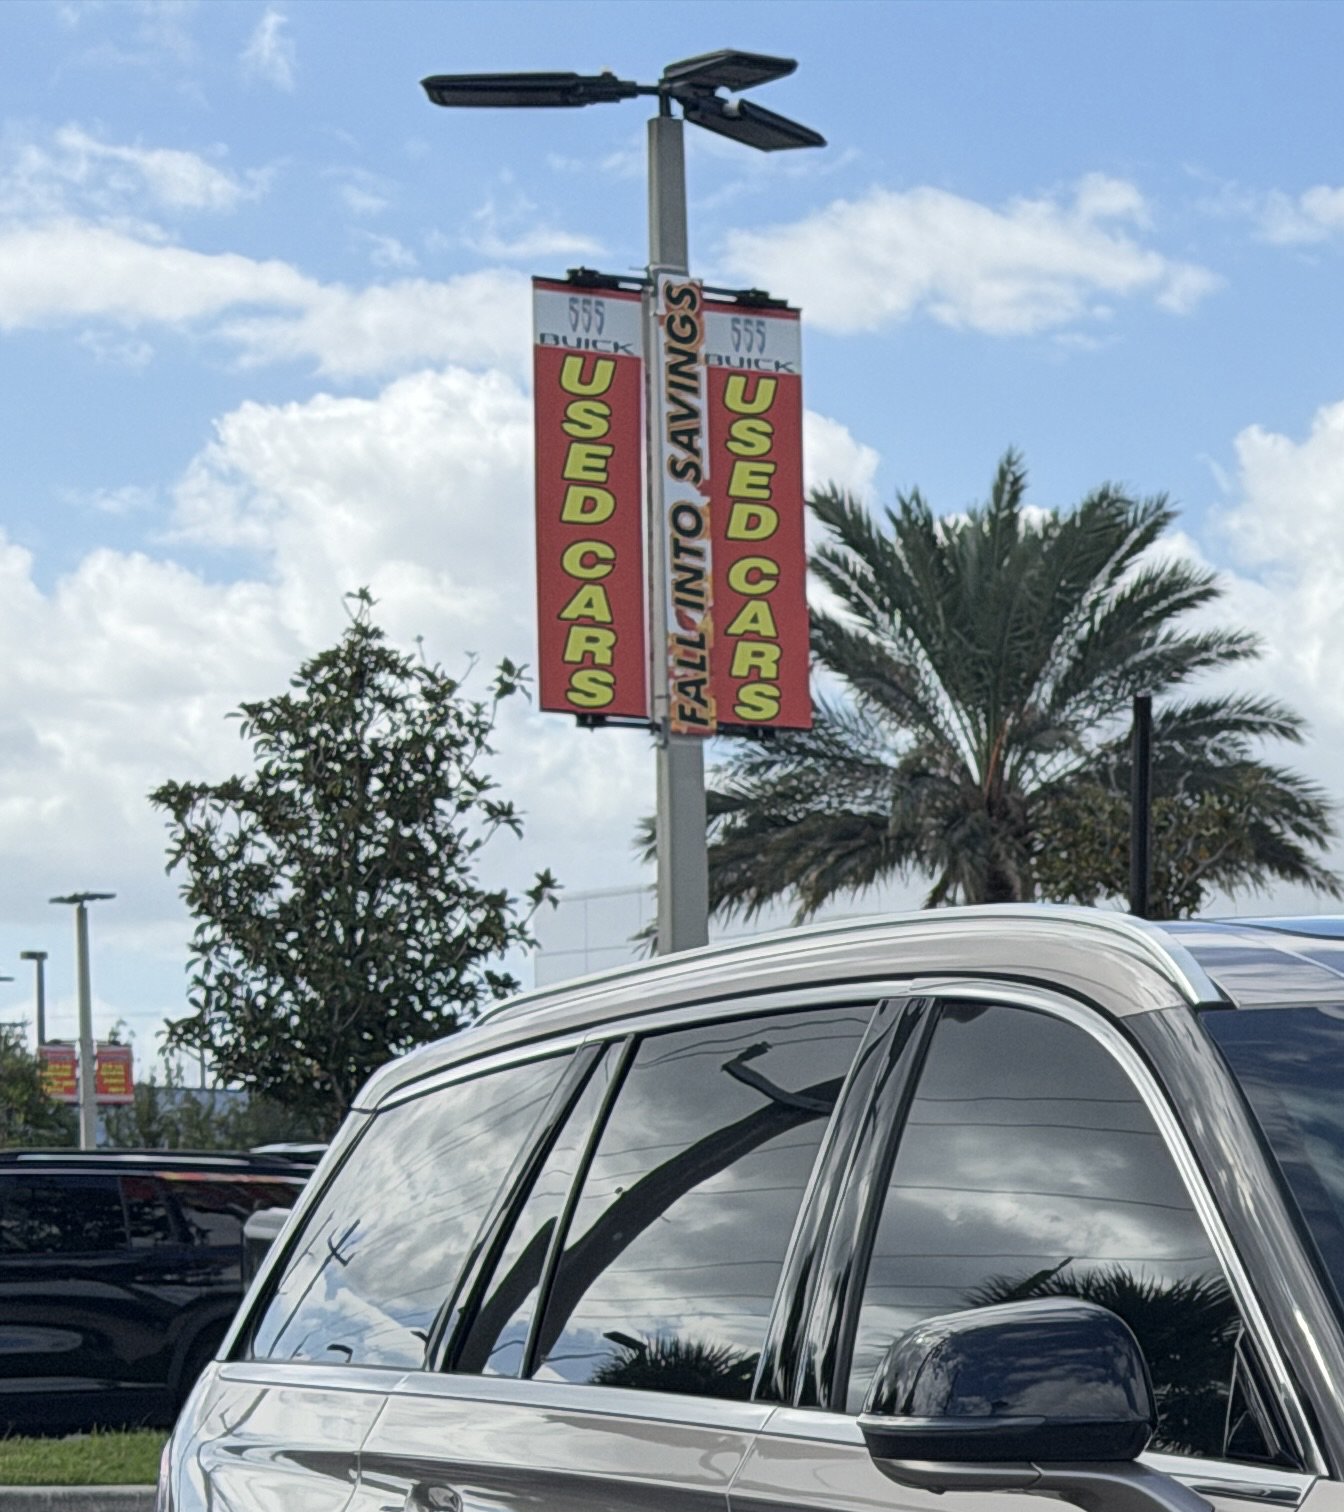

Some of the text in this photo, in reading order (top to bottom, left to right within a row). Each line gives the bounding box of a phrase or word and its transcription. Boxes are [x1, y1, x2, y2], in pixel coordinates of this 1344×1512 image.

[539, 332, 635, 356] BUICK
[665, 280, 710, 728] FALL INTO SAVINGS
[704, 353, 796, 374] BUICK
[558, 353, 618, 709] USED CARS
[723, 372, 782, 722] USED CARS
